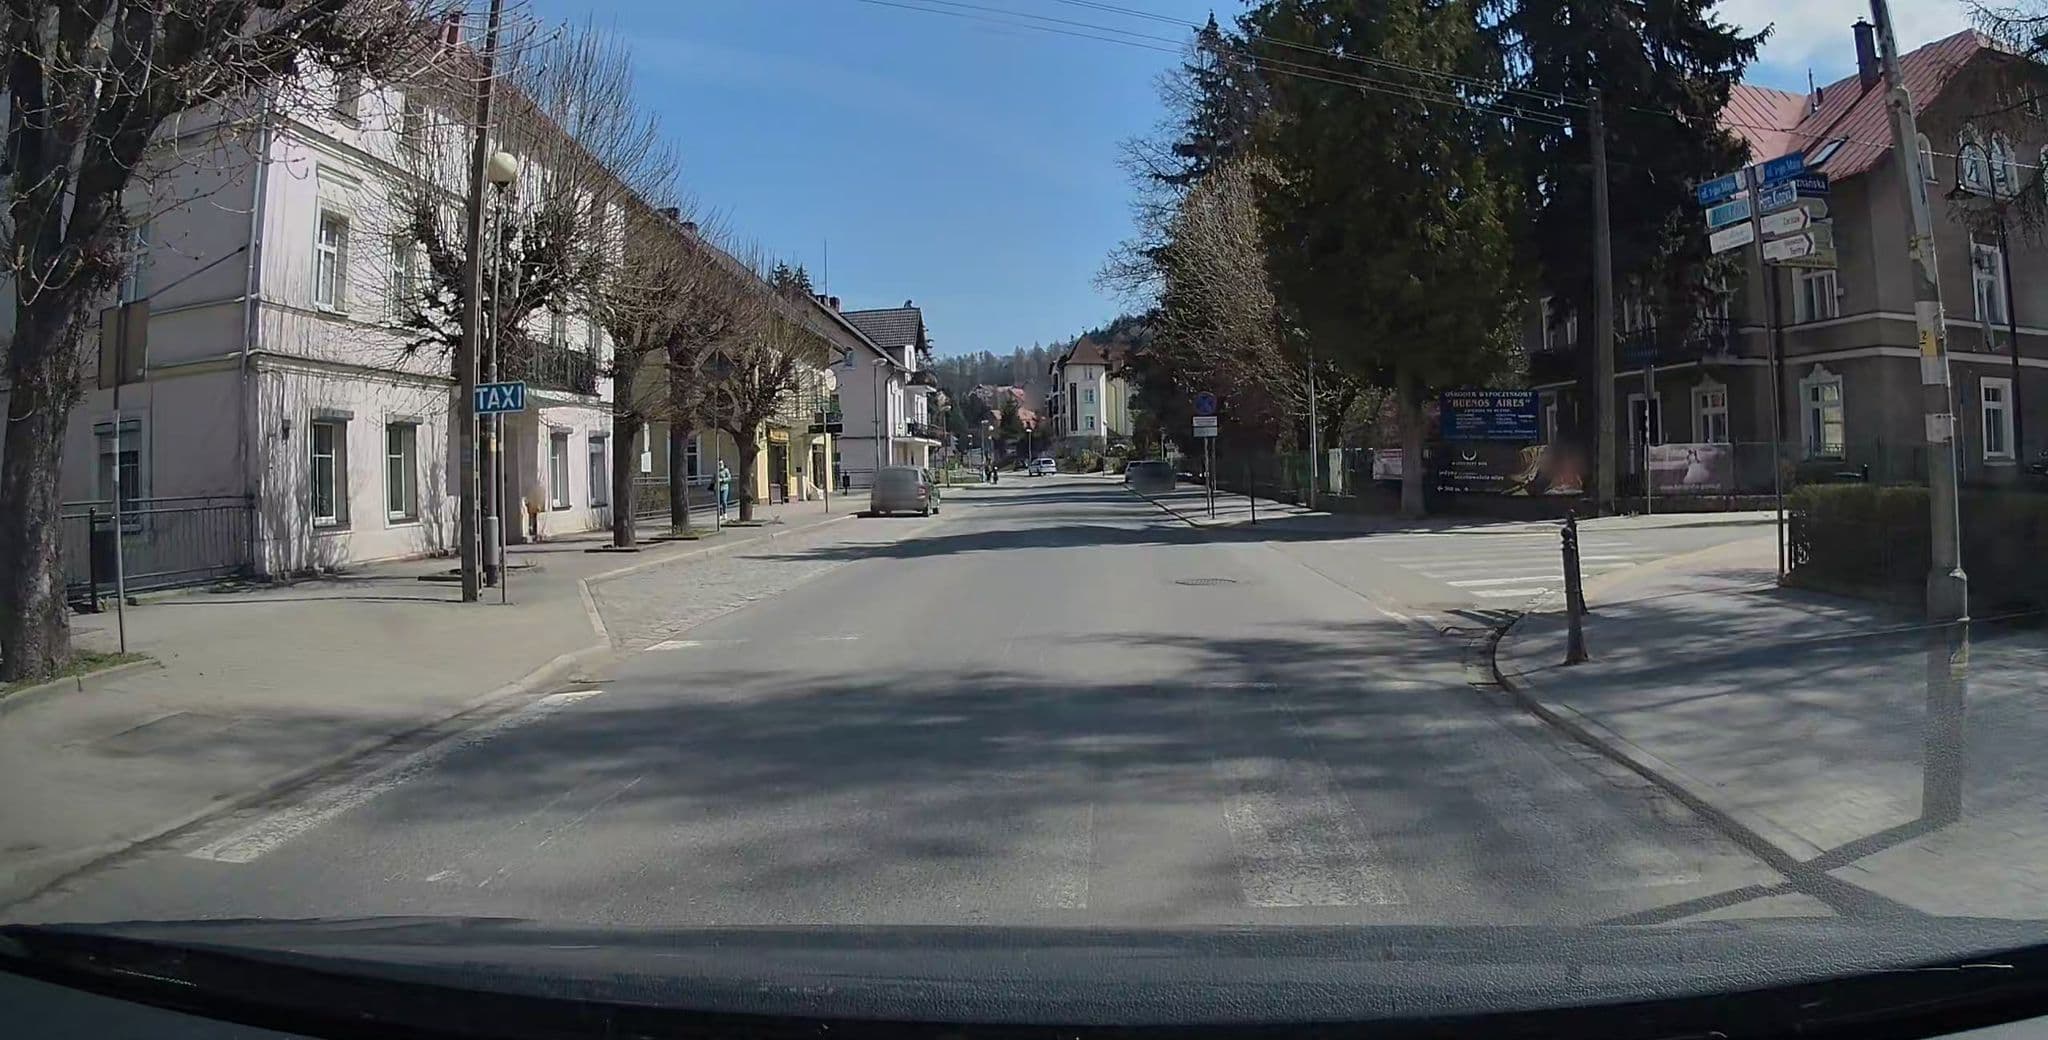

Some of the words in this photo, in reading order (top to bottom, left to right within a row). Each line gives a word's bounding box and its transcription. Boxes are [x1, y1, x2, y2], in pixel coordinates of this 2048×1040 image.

[475, 385, 522, 410] TAXI
[1447, 399, 1490, 408] "BUENOS
[1496, 399, 1531, 408] AIRES"
